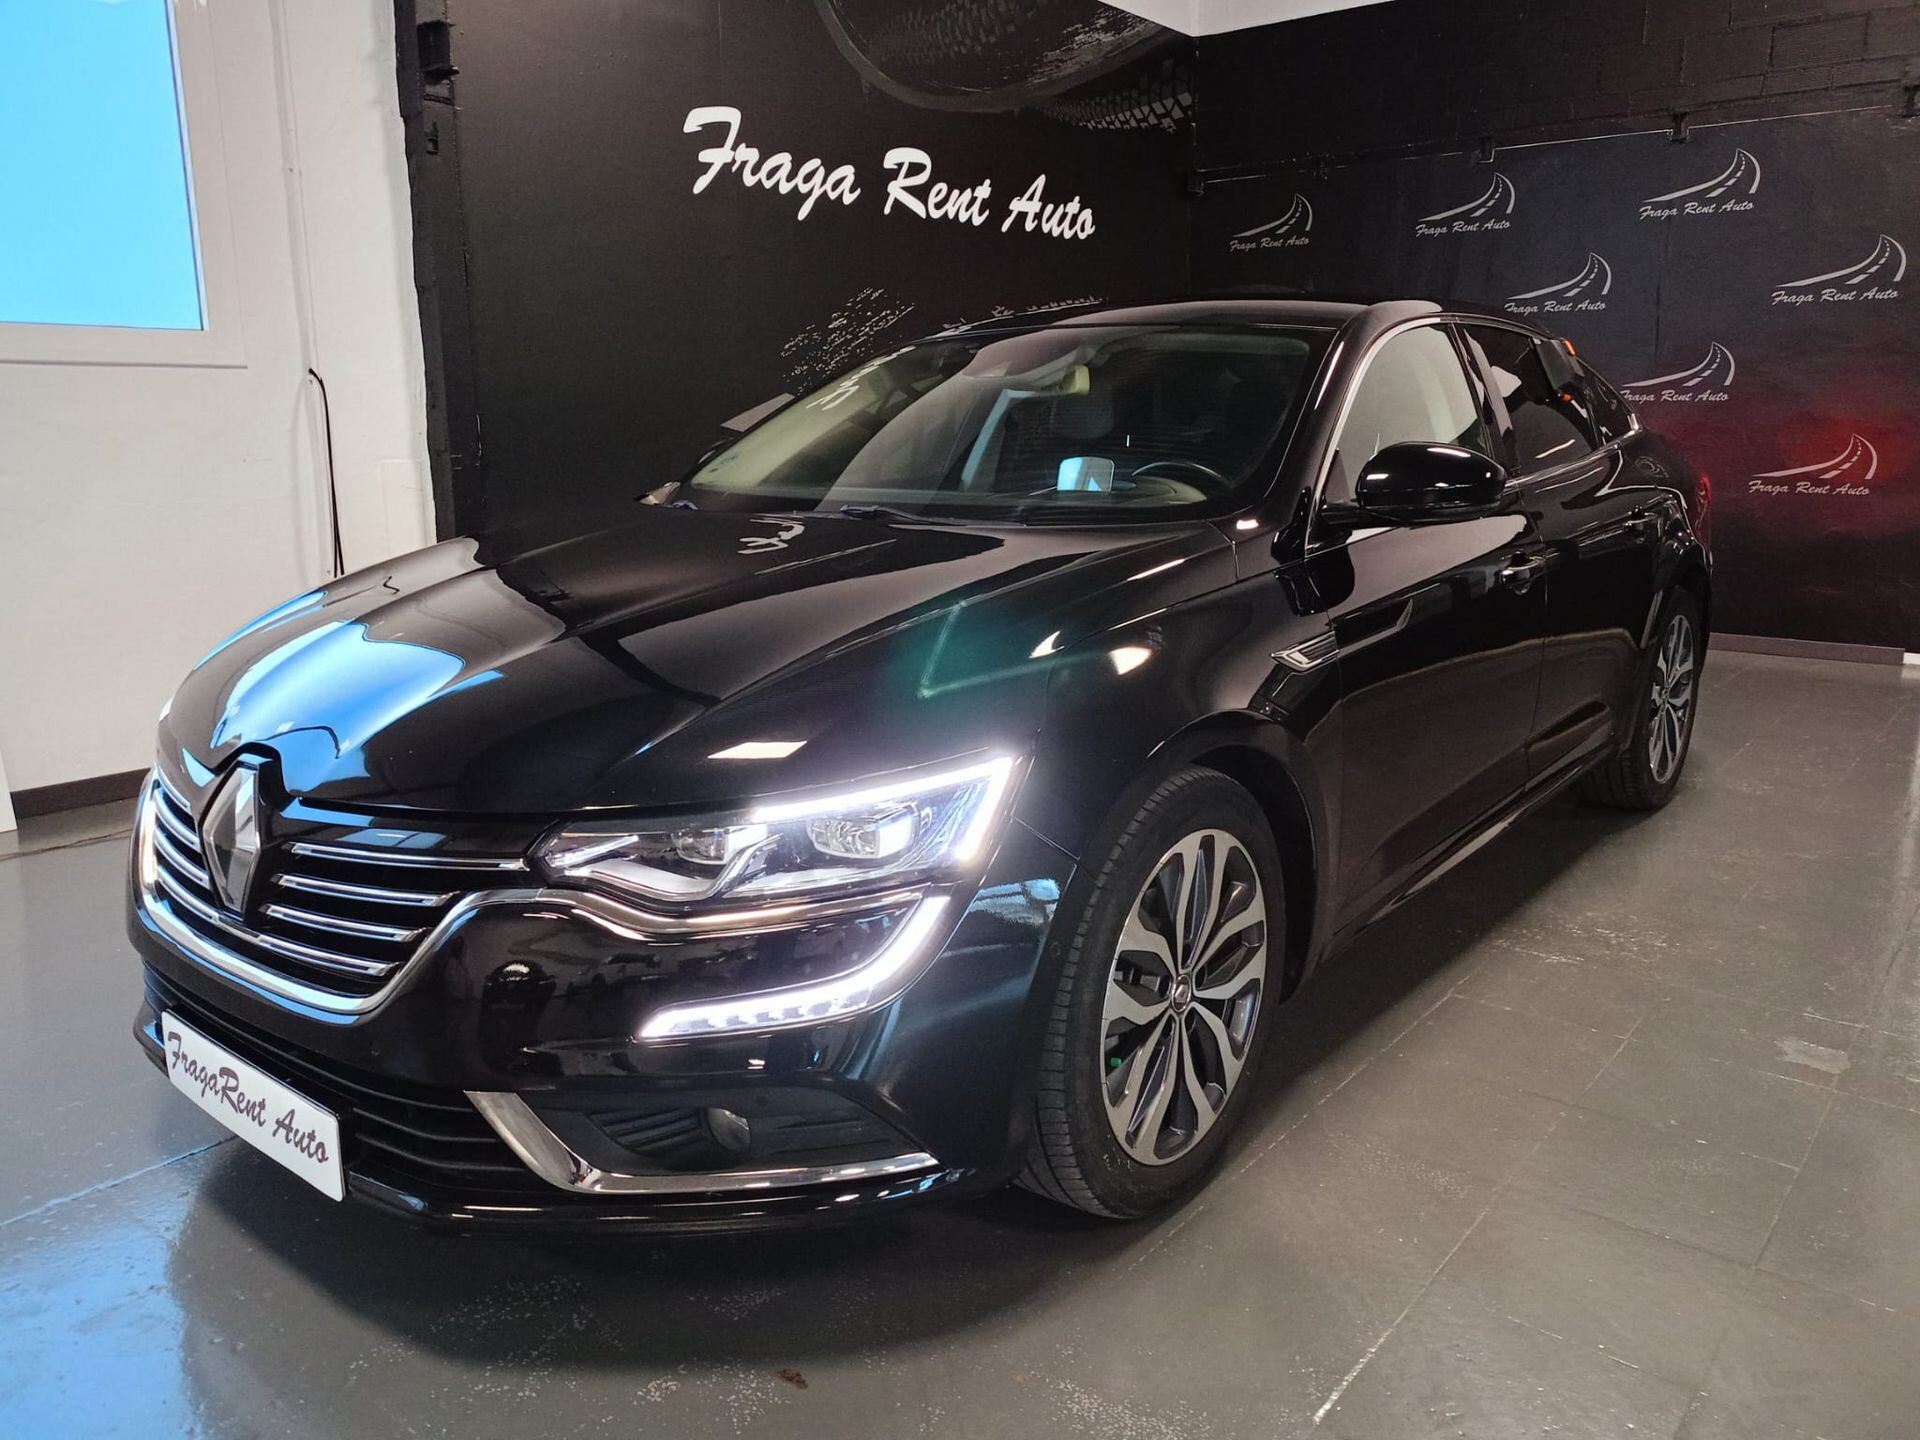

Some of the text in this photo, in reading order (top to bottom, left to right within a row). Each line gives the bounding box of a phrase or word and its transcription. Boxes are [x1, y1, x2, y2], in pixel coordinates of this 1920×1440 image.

[682, 105, 1096, 240] Fraga Rent Auto
[1639, 198, 1755, 221] Fraga Rent Auto
[1415, 218, 1511, 238] Fraga Rent Auto
[1229, 234, 1310, 252] Fraga Rent Auto
[1771, 286, 1899, 306] Fraga Rent Auto
[1504, 299, 1607, 317] Fraga Rent Auto
[1660, 389, 1694, 402] Rent
[1694, 389, 1730, 402] Auto
[1748, 479, 1871, 496] Fraga Rent Auto
[272, 1108, 330, 1164] Auto
